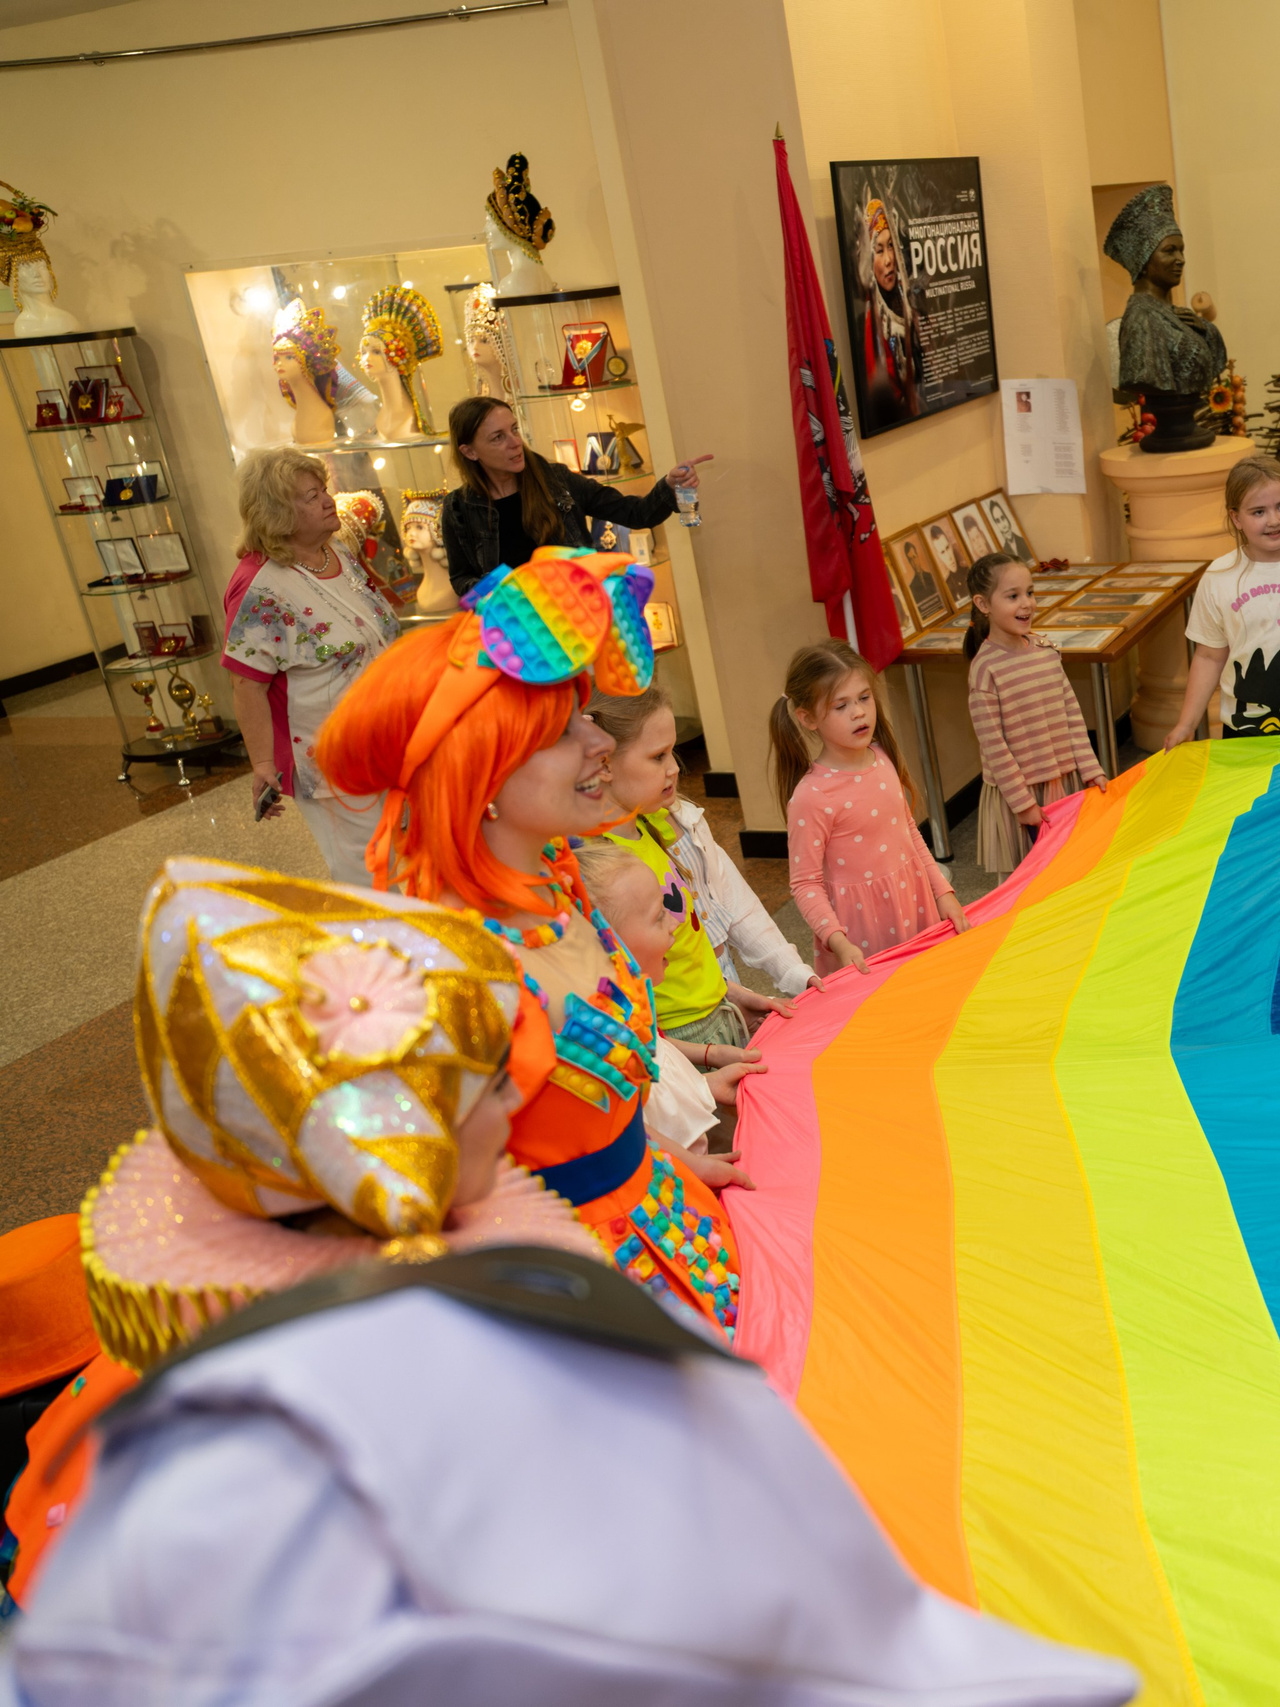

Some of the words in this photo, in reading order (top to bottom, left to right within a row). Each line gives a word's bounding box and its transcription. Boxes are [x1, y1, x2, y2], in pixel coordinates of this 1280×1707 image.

[908, 219, 979, 240] МНОГОНАЦИОНАЛЬНАЯ
[910, 233, 982, 279] РОССИЯ
[925, 283, 960, 299] MULTINATIONAL
[960, 280, 976, 291] RUSSIA
[1231, 592, 1250, 612] BAD
